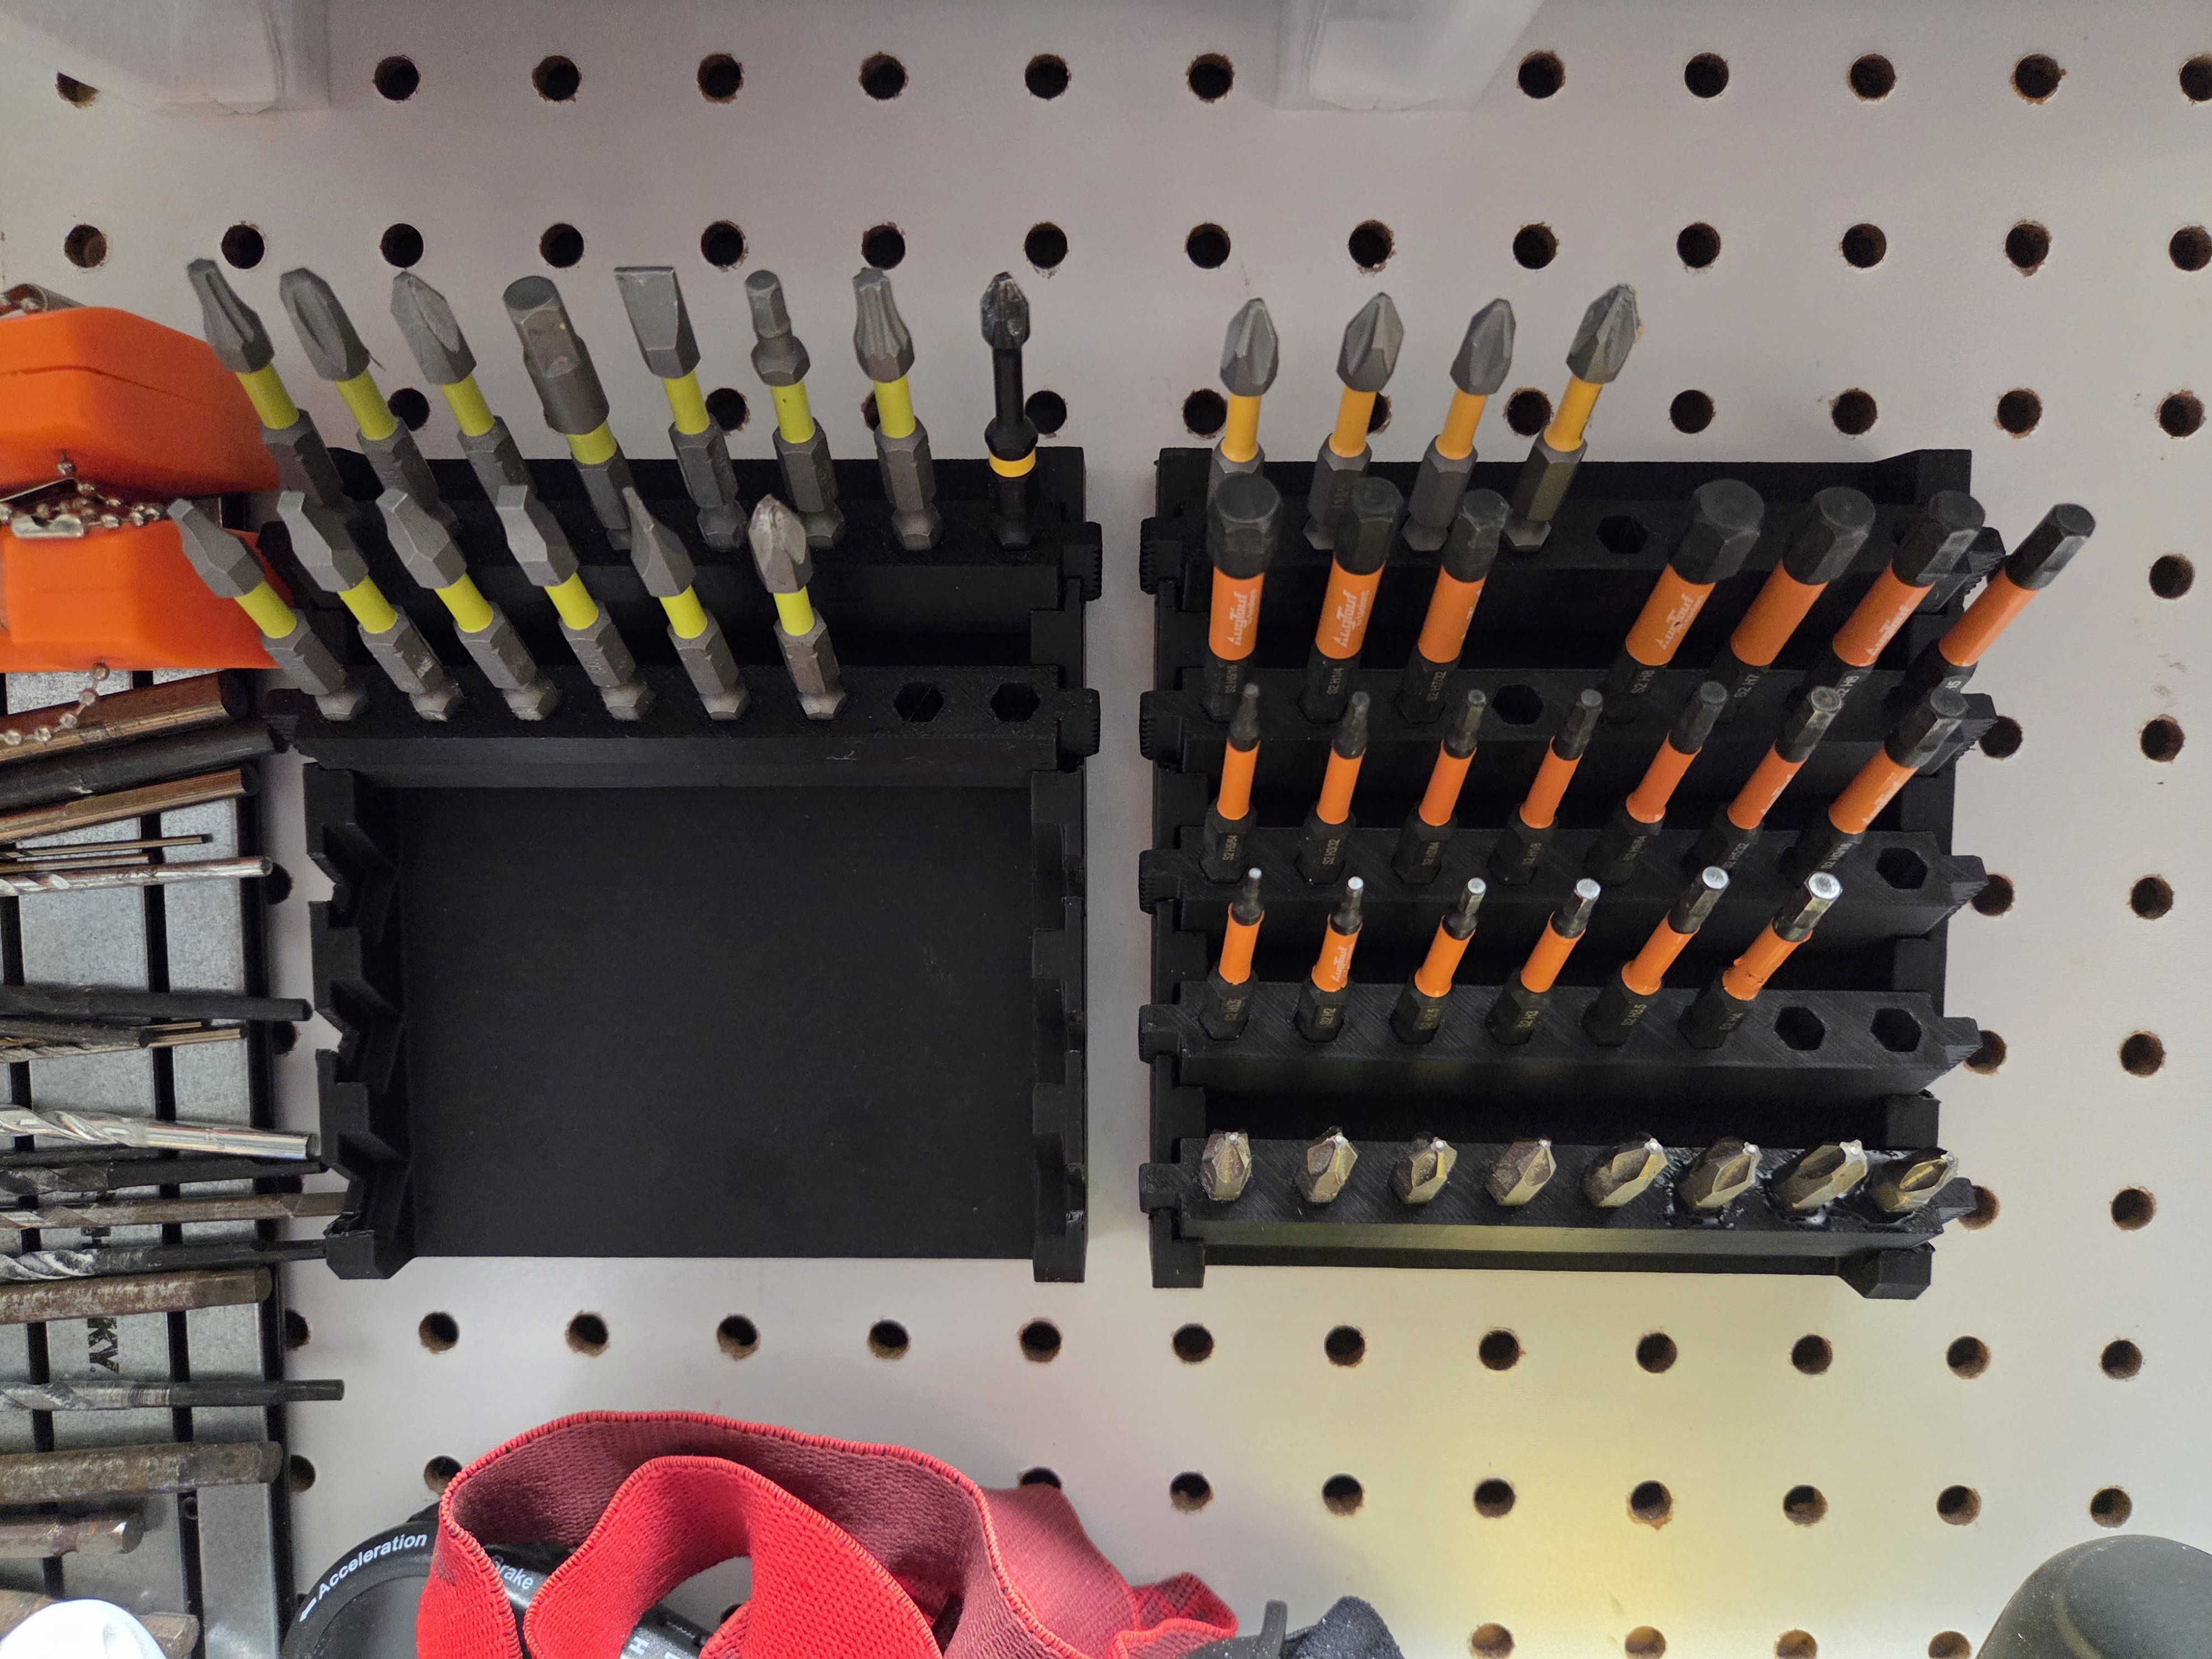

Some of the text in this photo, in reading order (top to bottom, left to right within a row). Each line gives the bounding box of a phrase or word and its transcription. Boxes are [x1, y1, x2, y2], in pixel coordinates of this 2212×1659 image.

[1631, 670, 1655, 693] S2 H8
[1734, 674, 1760, 697] S2 H7
[1327, 685, 1340, 695] S2
[1322, 1008, 1336, 1016] H2
[1521, 1010, 1538, 1019] H3
[318, 1533, 427, 1600] Acceleration
